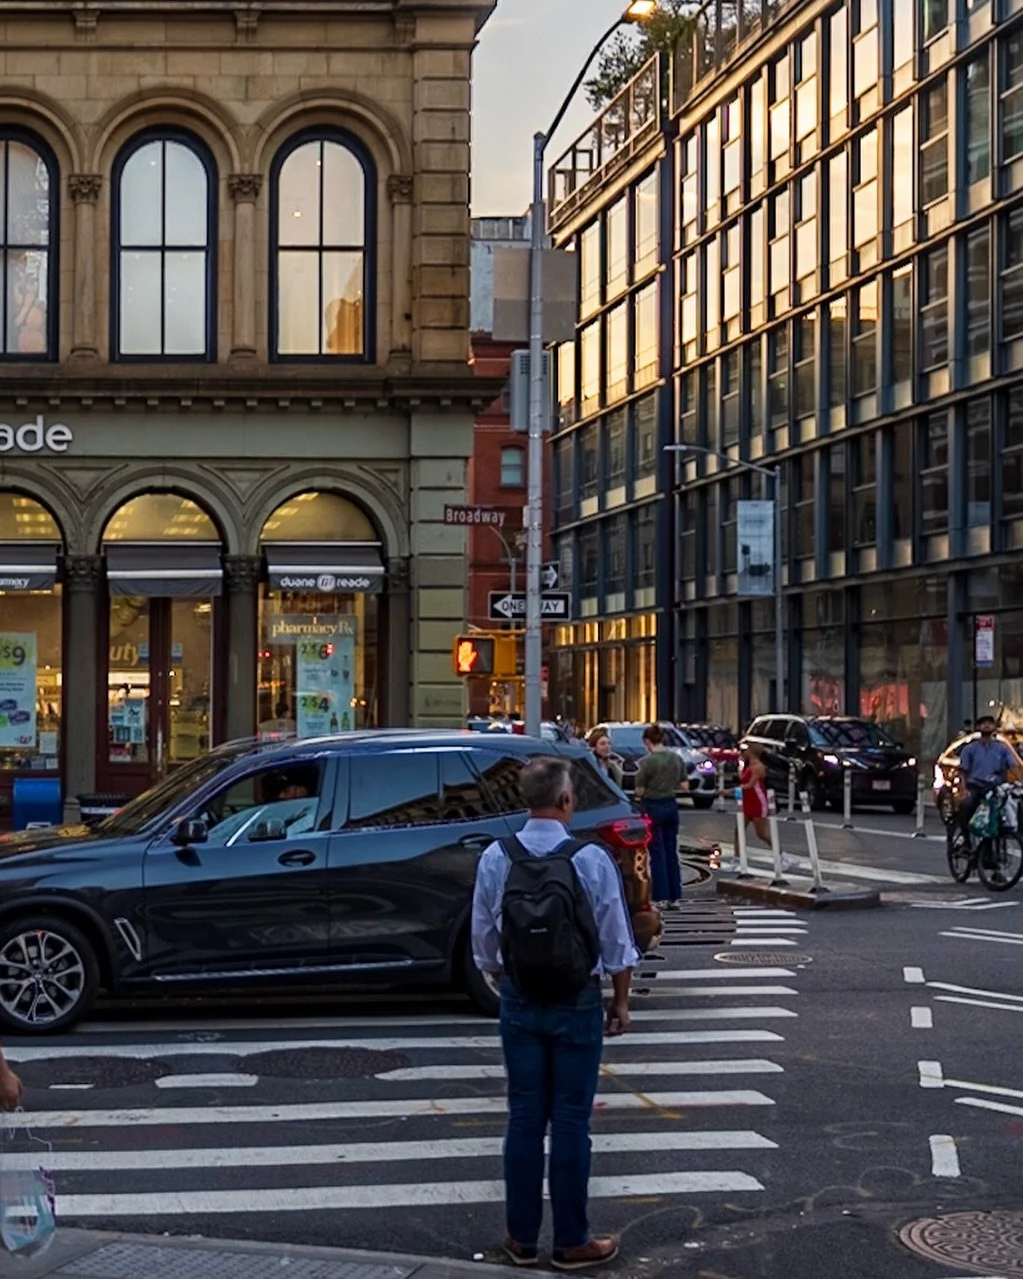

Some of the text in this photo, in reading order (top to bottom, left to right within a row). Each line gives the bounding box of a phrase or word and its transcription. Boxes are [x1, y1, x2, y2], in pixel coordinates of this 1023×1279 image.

[445, 507, 506, 527] Broadway
[280, 576, 316, 587] duane
[336, 576, 370, 588] reade
[501, 600, 559, 611] ONE AY
[272, 620, 338, 638] pharmacy
